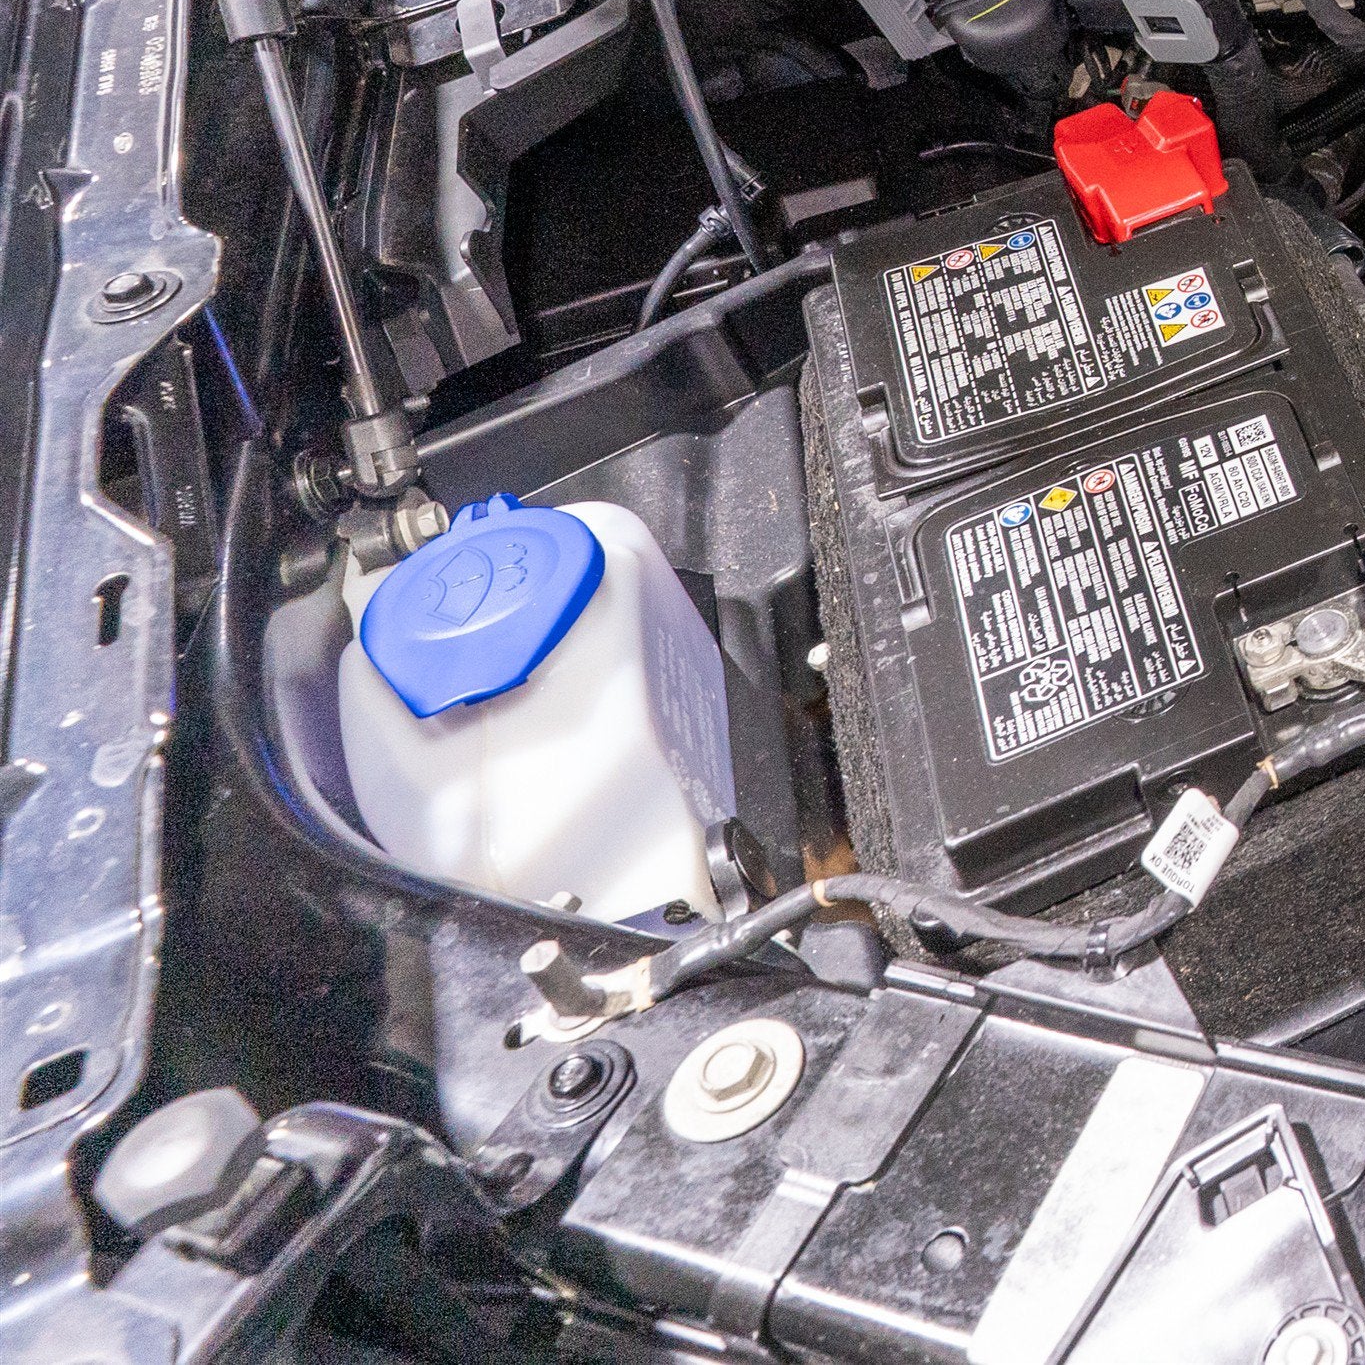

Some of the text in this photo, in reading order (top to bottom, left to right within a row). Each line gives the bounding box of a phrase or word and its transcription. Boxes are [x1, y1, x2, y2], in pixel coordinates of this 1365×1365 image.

[1198, 442, 1212, 459] 12V
[1177, 459, 1199, 482] MF
[1228, 465, 1251, 508] 80 Ah C20
[1250, 468, 1263, 482] CCA
[1182, 484, 1212, 532] FoMoCo
[1208, 470, 1233, 518] AGM/VRLA
